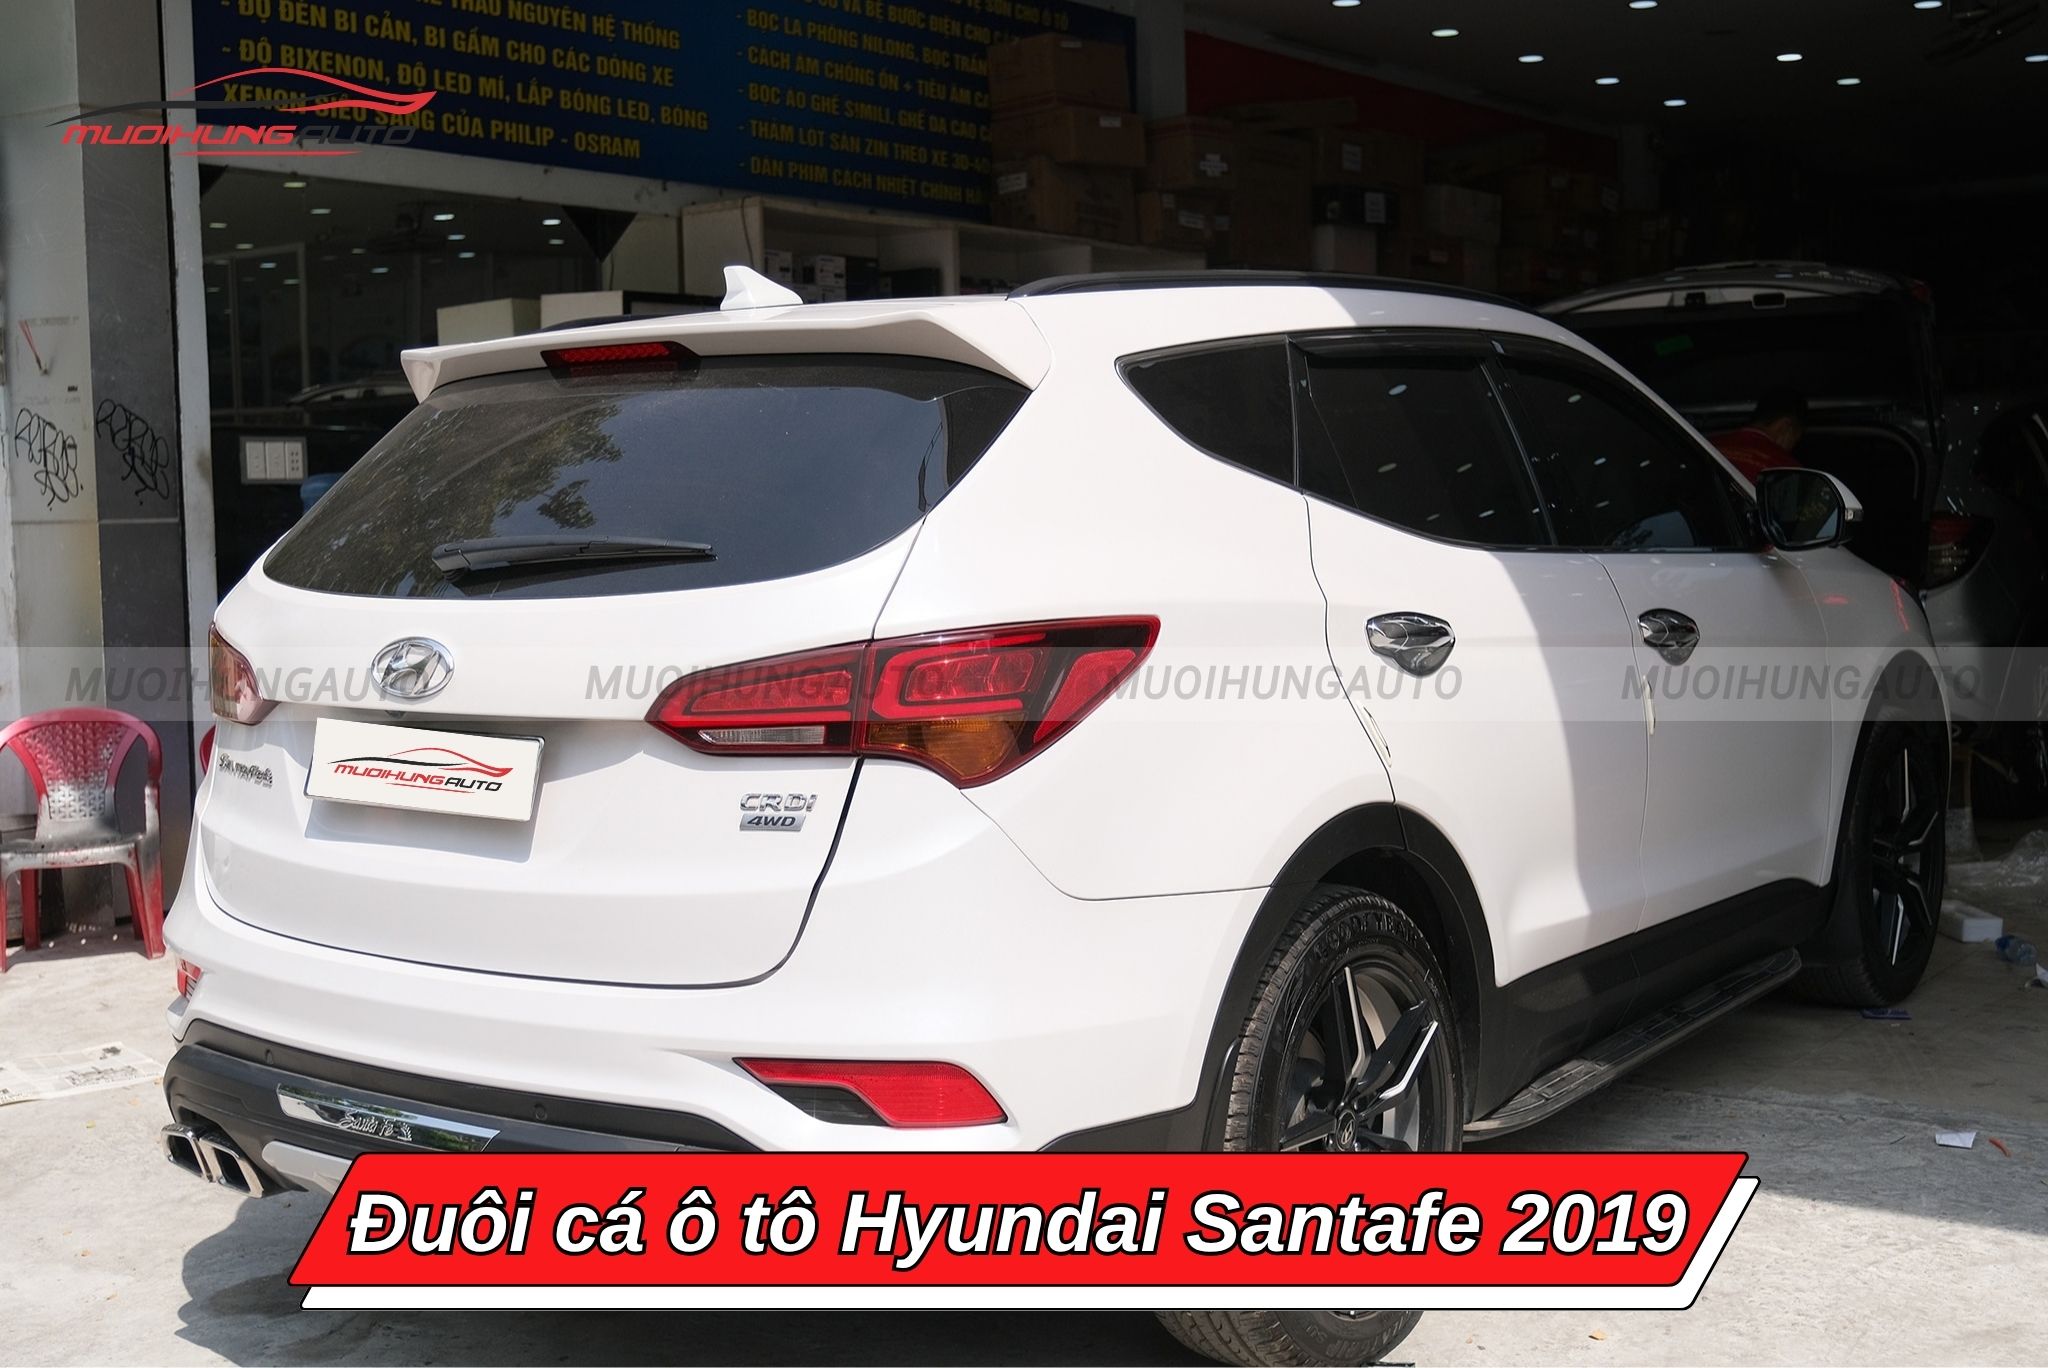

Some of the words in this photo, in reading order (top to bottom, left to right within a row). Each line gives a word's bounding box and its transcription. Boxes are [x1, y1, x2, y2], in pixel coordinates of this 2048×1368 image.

[333, 8, 358, 34] BI
[423, 24, 447, 49] BI
[505, 39, 547, 65] CHO
[551, 46, 591, 73] CÁC
[651, 64, 675, 88] XE
[591, 13, 616, 42] HỆ
[621, 19, 681, 50] THỐNG
[239, 35, 273, 67] ĐỘ
[280, 43, 391, 87] BIXENON,
[397, 60, 427, 92] ĐỘ
[433, 68, 473, 96] LED
[559, 87, 612, 117] BÓNG
[660, 103, 709, 131] BÓNG
[441, 108, 485, 139] CỦA
[490, 119, 555, 148] PHILIP
[573, 130, 641, 160] OSRAM
[928, 115, 948, 135] DA
[863, 138, 889, 159] ZIN
[893, 142, 928, 165] THEO
[930, 148, 949, 168] XE
[787, 160, 828, 184] PHIM
[747, 815, 797, 827] 4WD
